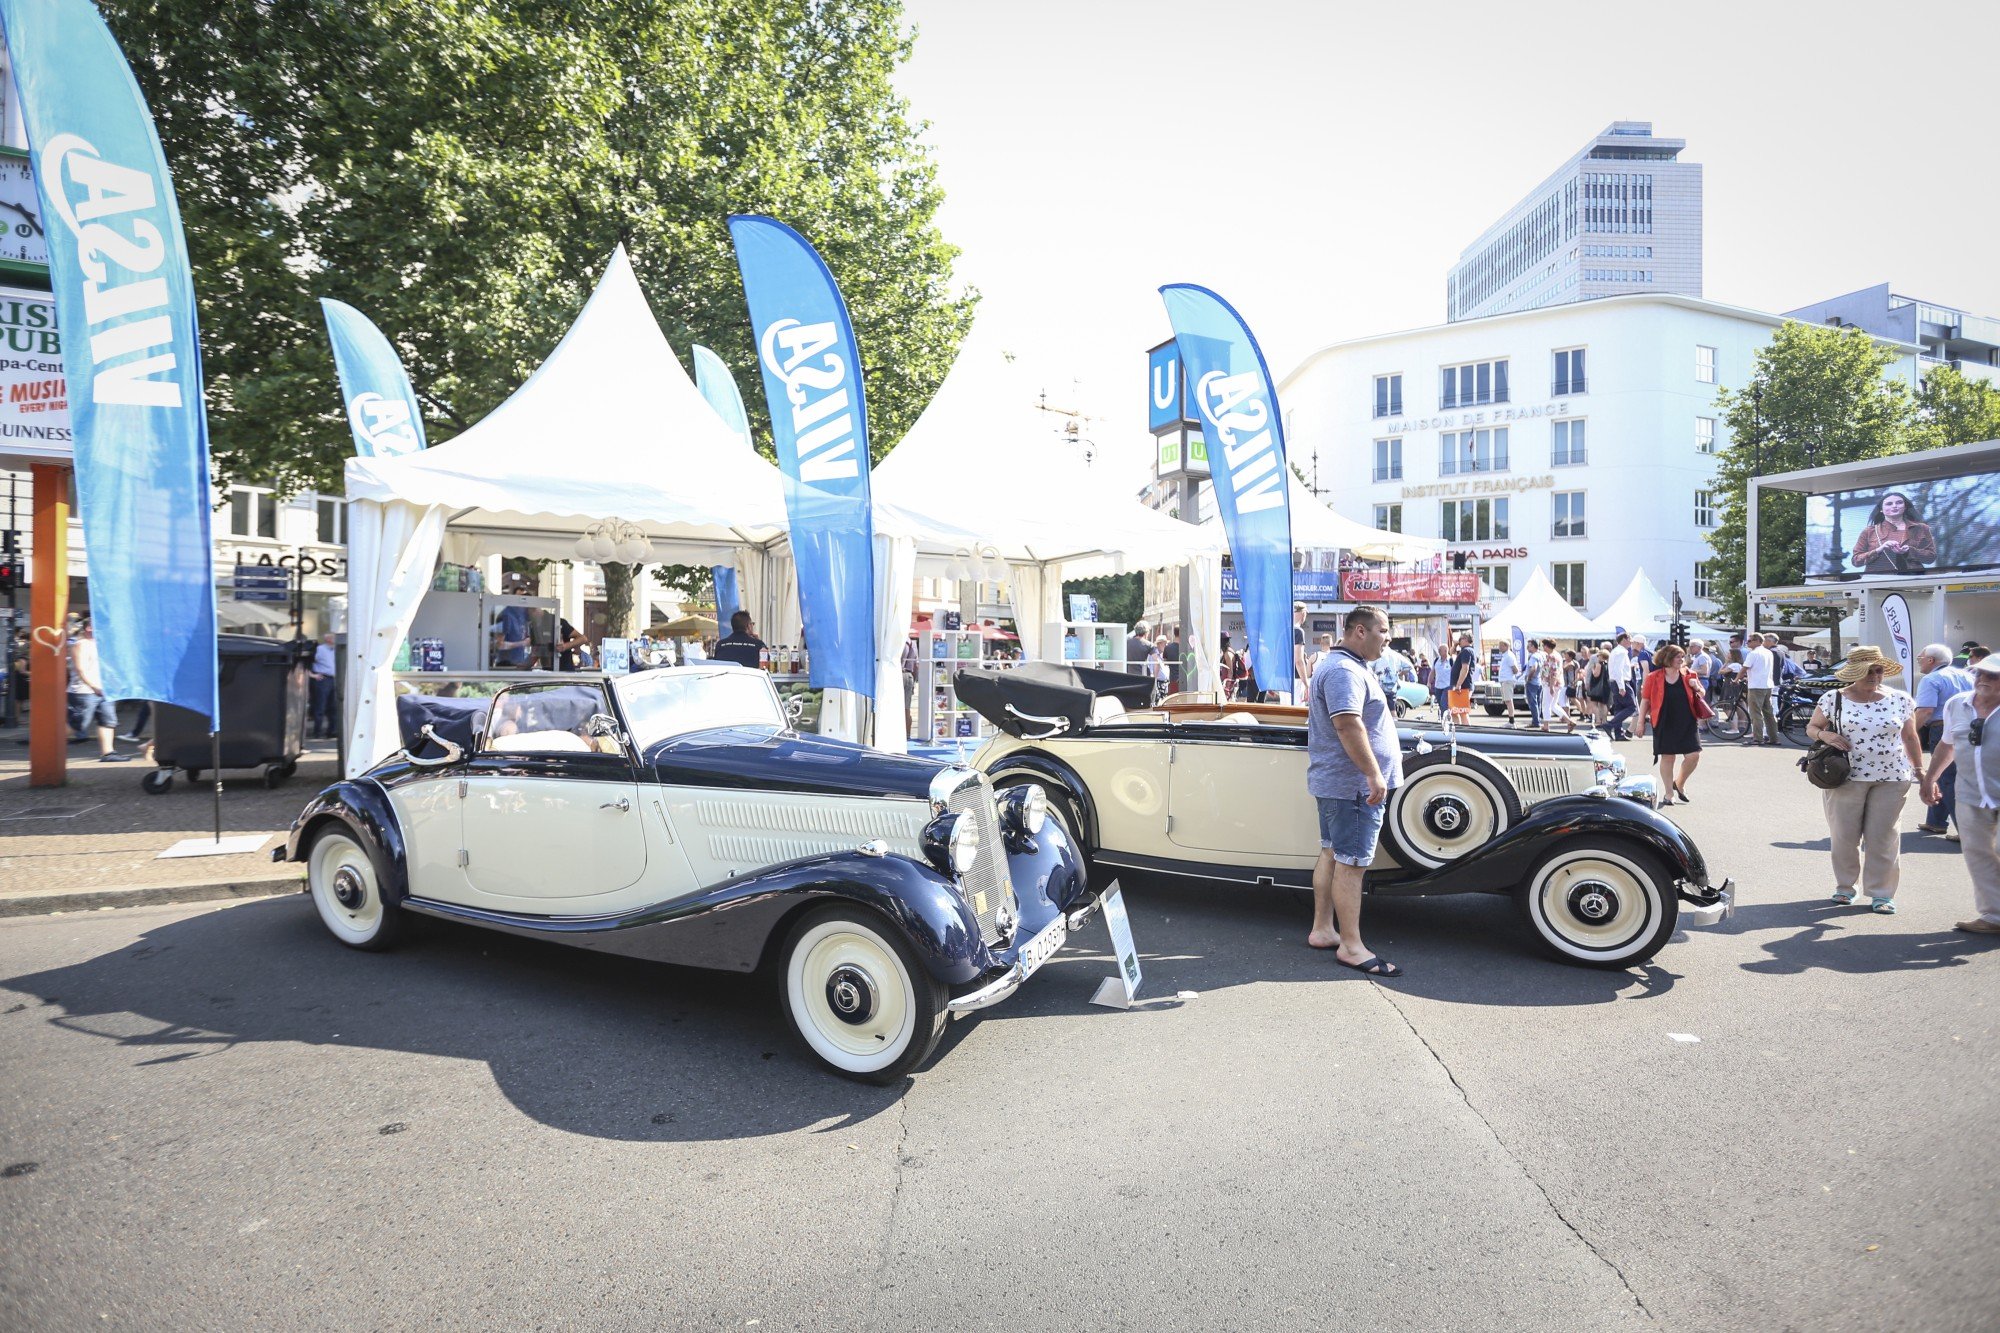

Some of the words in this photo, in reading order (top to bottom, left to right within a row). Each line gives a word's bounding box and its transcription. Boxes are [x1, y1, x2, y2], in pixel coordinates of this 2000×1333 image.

[20, 172, 31, 180] 12
[1154, 359, 1176, 410] U
[1388, 415, 1454, 434] MAISON
[1462, 412, 1485, 425] DE
[1494, 402, 1570, 420] FRANCE
[0, 422, 72, 441] UINNESS
[1401, 481, 1469, 499] INSTITUT
[1472, 475, 1556, 494] FRANÇAIS
[237, 551, 348, 576] ACOST
[1482, 547, 1528, 559] PARIS
[1442, 581, 1472, 589] CLASSIC
[1027, 949, 1033, 970] B
